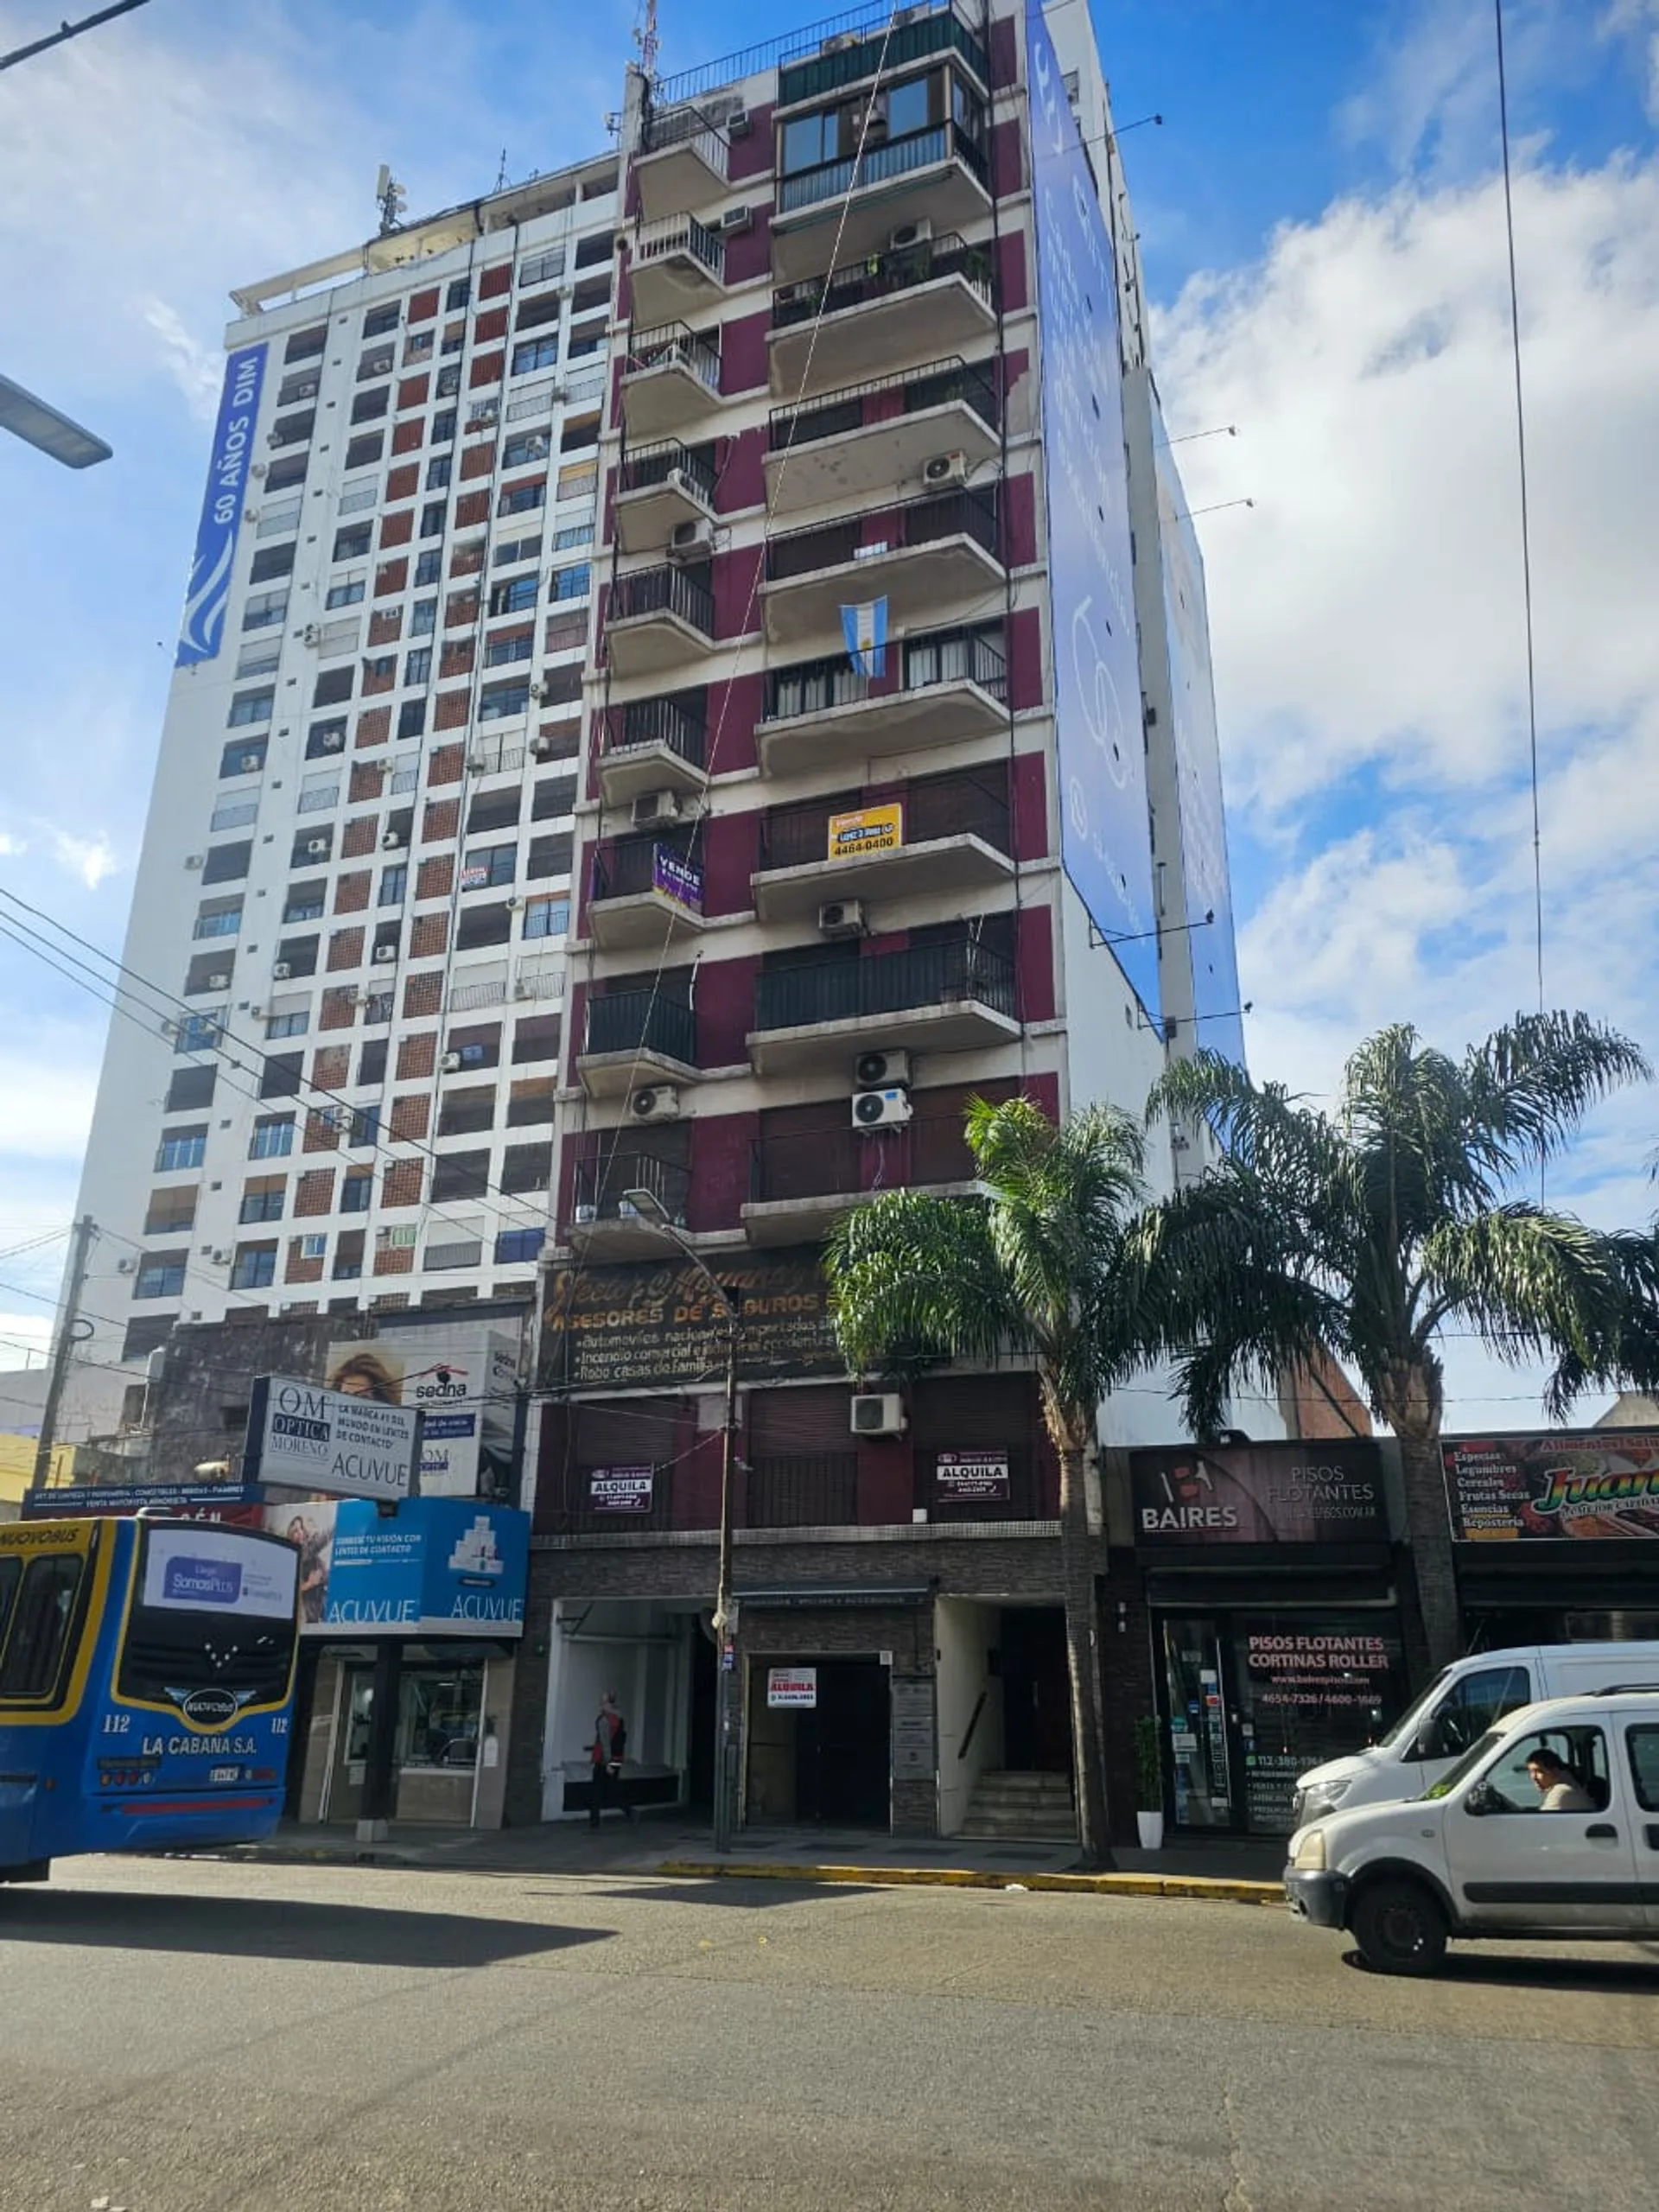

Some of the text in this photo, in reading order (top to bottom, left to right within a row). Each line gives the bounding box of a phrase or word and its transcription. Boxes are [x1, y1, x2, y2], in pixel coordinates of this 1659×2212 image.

[214, 356, 258, 524] 60 AÑOS DIM
[834, 836, 893, 855] 4464-0400
[659, 855, 701, 887] VENDE
[674, 1306, 703, 1323] DE
[711, 1294, 818, 1319] SGUROS
[279, 1386, 328, 1420] OM
[274, 1415, 330, 1441] OPTICA
[270, 1435, 328, 1458] MORENO
[1453, 1452, 1502, 1464] Especias
[331, 1452, 410, 1487] ACUVUE
[943, 1466, 1002, 1478] ALQUILA
[1291, 1465, 1344, 1483] PISOS
[1455, 1464, 1516, 1478] Legumbres
[594, 1480, 646, 1493] ALQUILA
[1457, 1476, 1504, 1487] Cereales
[1459, 1490, 1531, 1502] Frutas Secas
[1141, 1507, 1238, 1529] BAIRES
[1460, 1503, 1510, 1515] Esencias
[328, 1599, 416, 1624] ACUVUE
[449, 1594, 526, 1621] ACUVUE
[1249, 1637, 1384, 1650] PISOS FLOTANTES
[1249, 1653, 1389, 1669] CORTINAS ROLLER
[102, 1714, 130, 1733] 112
[271, 1716, 289, 1734] 112
[143, 1737, 163, 1755] LA
[233, 1736, 257, 1754] S.A.
